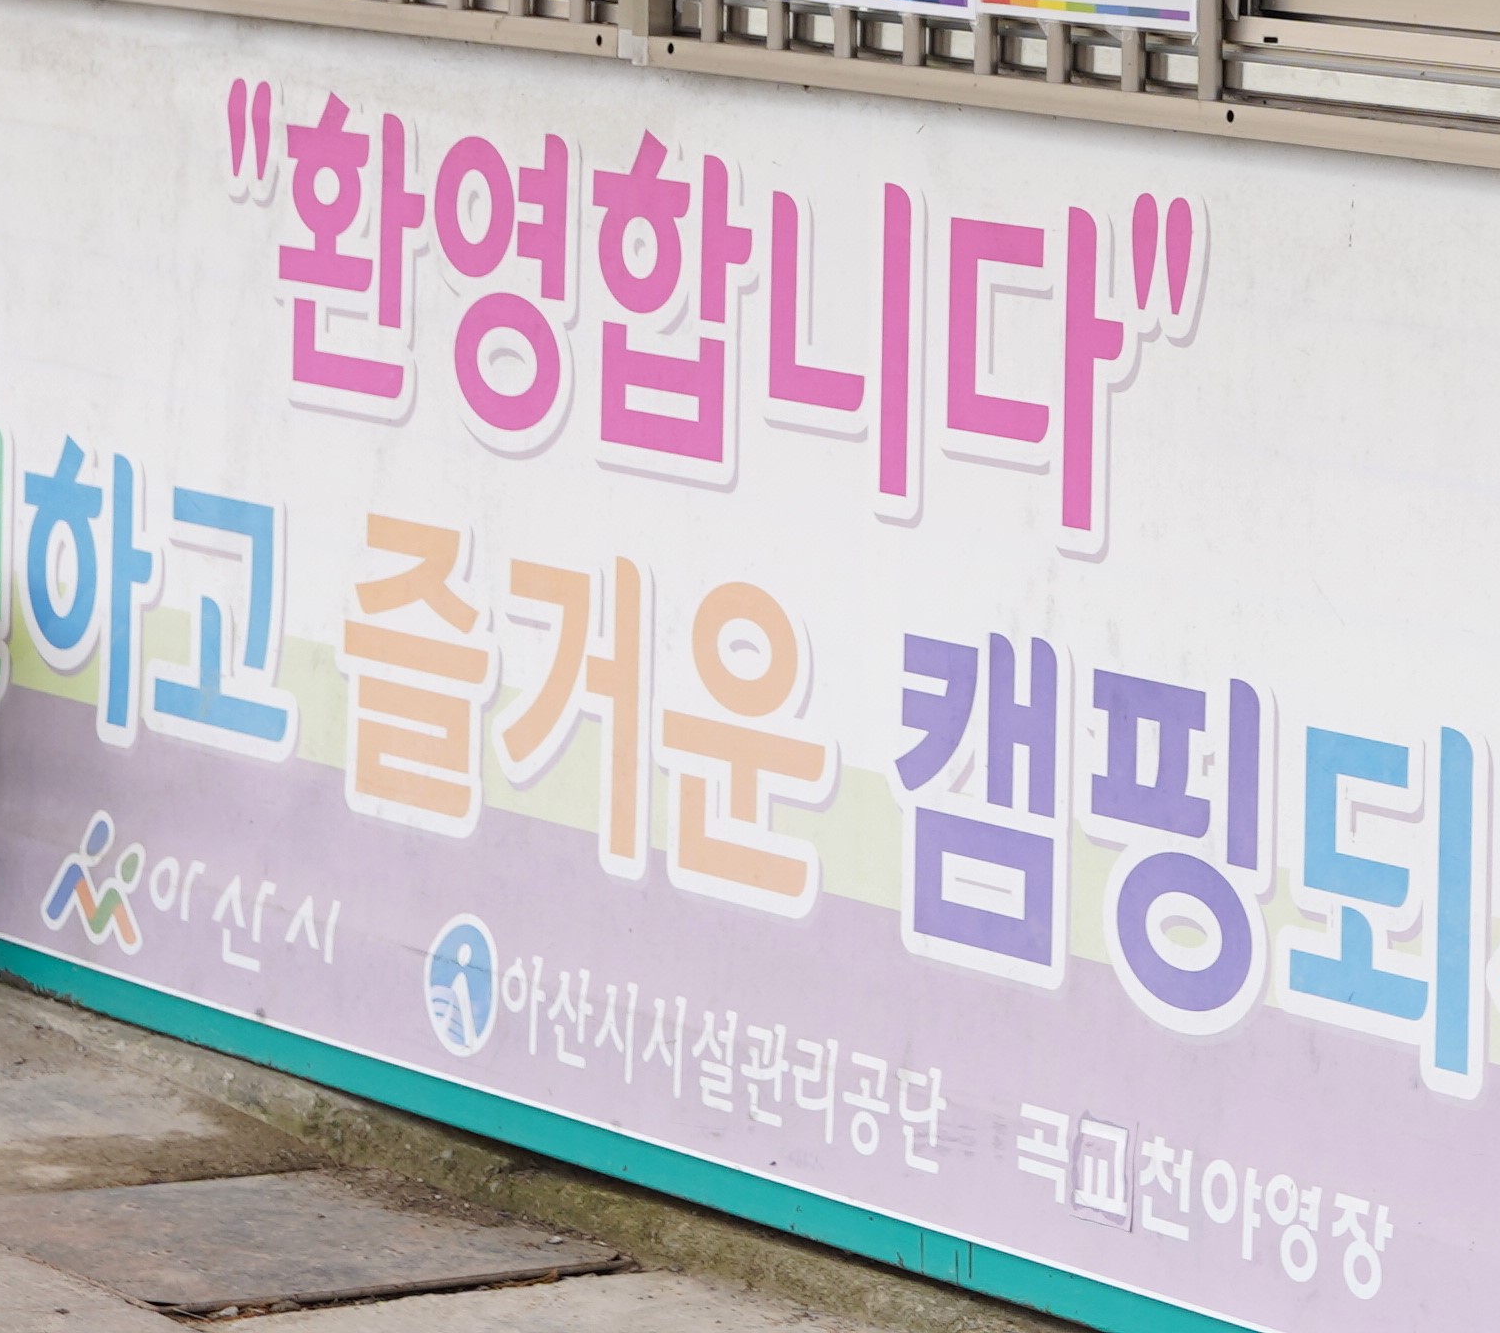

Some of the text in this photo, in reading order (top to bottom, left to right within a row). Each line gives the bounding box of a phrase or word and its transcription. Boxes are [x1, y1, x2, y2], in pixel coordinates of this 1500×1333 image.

[344, 514, 828, 899] 즐거운
[147, 853, 340, 973] 아산시
[501, 953, 1393, 1302] 아산시시설관리공단 곡교천야영장
